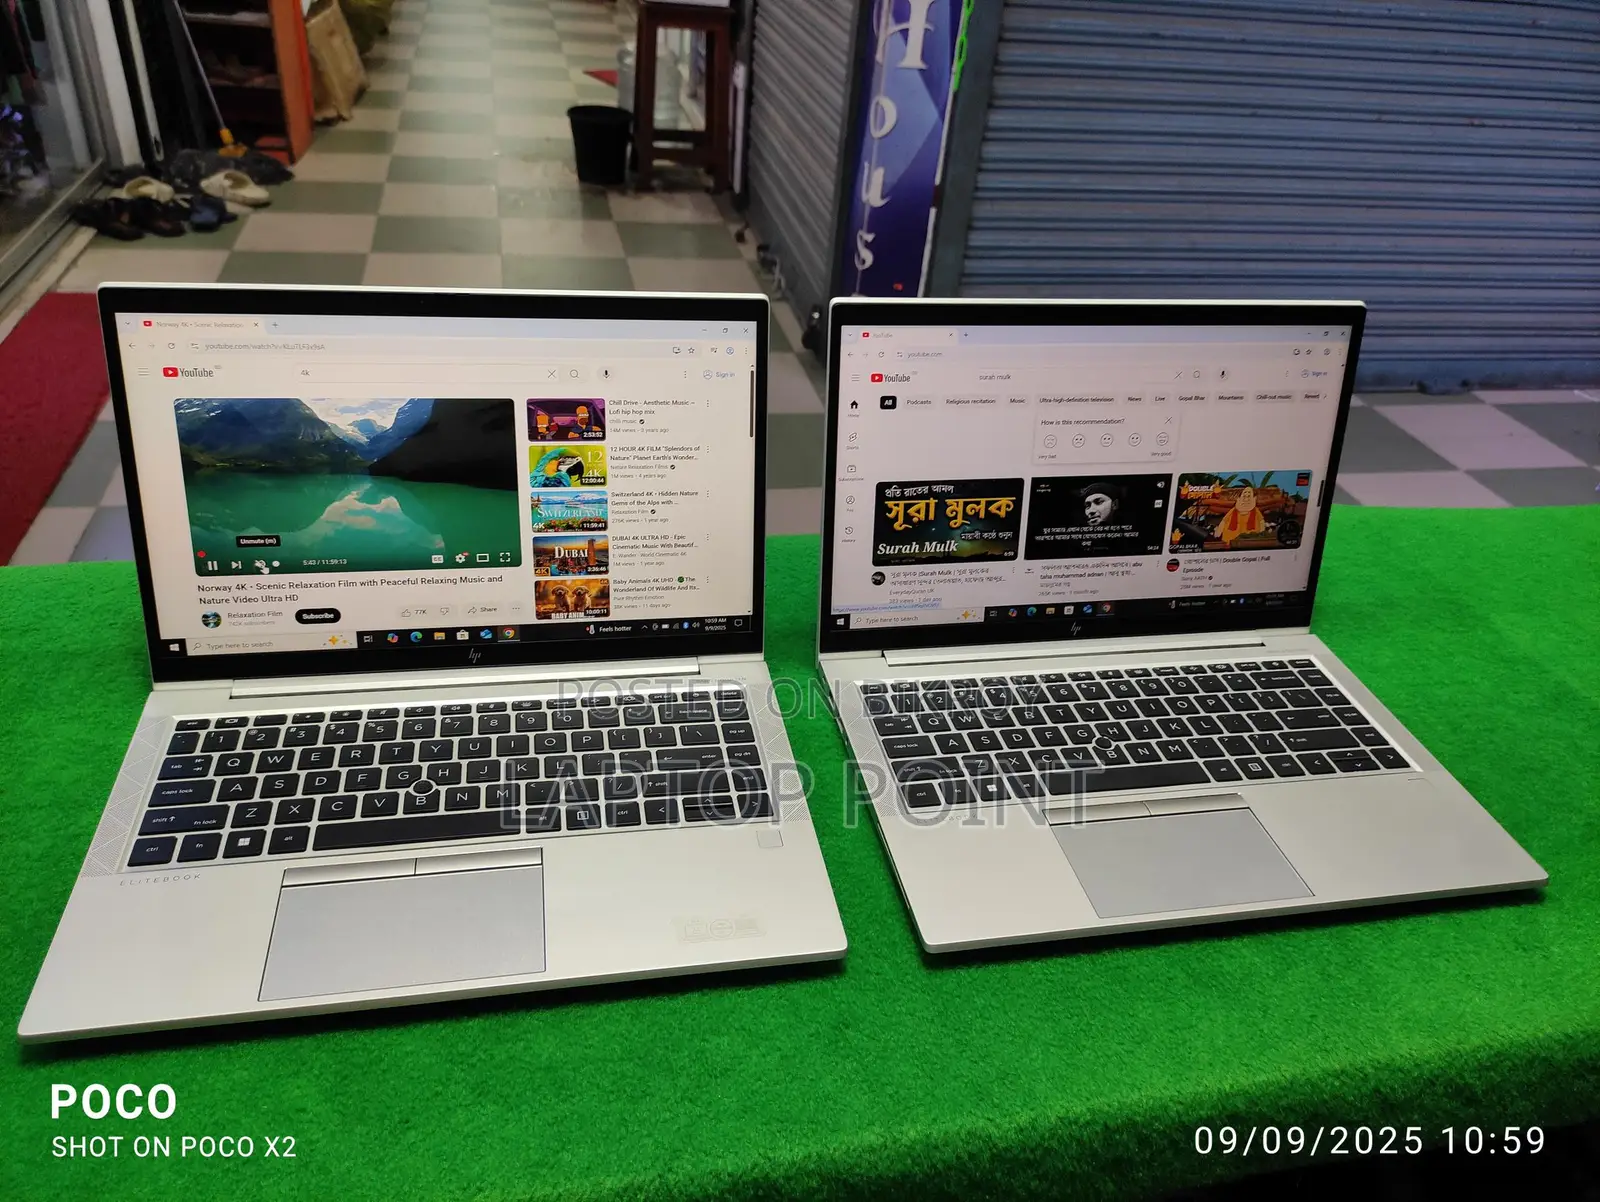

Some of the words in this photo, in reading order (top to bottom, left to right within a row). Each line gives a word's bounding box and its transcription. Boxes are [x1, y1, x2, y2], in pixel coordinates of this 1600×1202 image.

[855, 0, 934, 298] Hous
[179, 367, 214, 378] YouTube
[715, 371, 729, 379] Sign
[883, 374, 911, 382] YouTube
[945, 398, 970, 406] Religious
[587, 451, 603, 463] 12
[586, 469, 602, 477] 4K
[885, 485, 902, 498] প্রতি
[903, 485, 929, 496] রাতের
[930, 484, 954, 494] আমল
[537, 507, 604, 518] SWITZERLAND
[885, 497, 938, 531] সূরা
[945, 496, 1016, 529] মুলক
[554, 545, 587, 559] DUBAI
[877, 542, 920, 555] Surah
[921, 539, 959, 553] Mulk
[302, 558, 316, 566] 5:43
[197, 584, 232, 594] Norway
[235, 583, 248, 591] 4K
[255, 582, 286, 591] Scenic
[288, 580, 336, 590] Relaxation
[338, 579, 357, 588] Film
[359, 578, 378, 587] with
[380, 577, 419, 587] Peaceful
[420, 576, 458, 587] Relaxing
[459, 575, 485, 584] Music
[487, 574, 503, 583] and
[199, 596, 231, 605] Nature
[232, 595, 259, 604] Video
[261, 594, 283, 603] Ultra
[285, 594, 299, 602] HD
[227, 611, 265, 619] Relaxation
[267, 610, 284, 618] Film
[414, 608, 428, 616] 77K
[479, 606, 498, 614] Share
[302, 612, 335, 620] Subscribe
[599, 625, 614, 633] Feels
[614, 624, 632, 632] hotter
[205, 642, 224, 651] Type
[251, 640, 274, 648] search
[119, 873, 201, 886] ELITEBOOK
